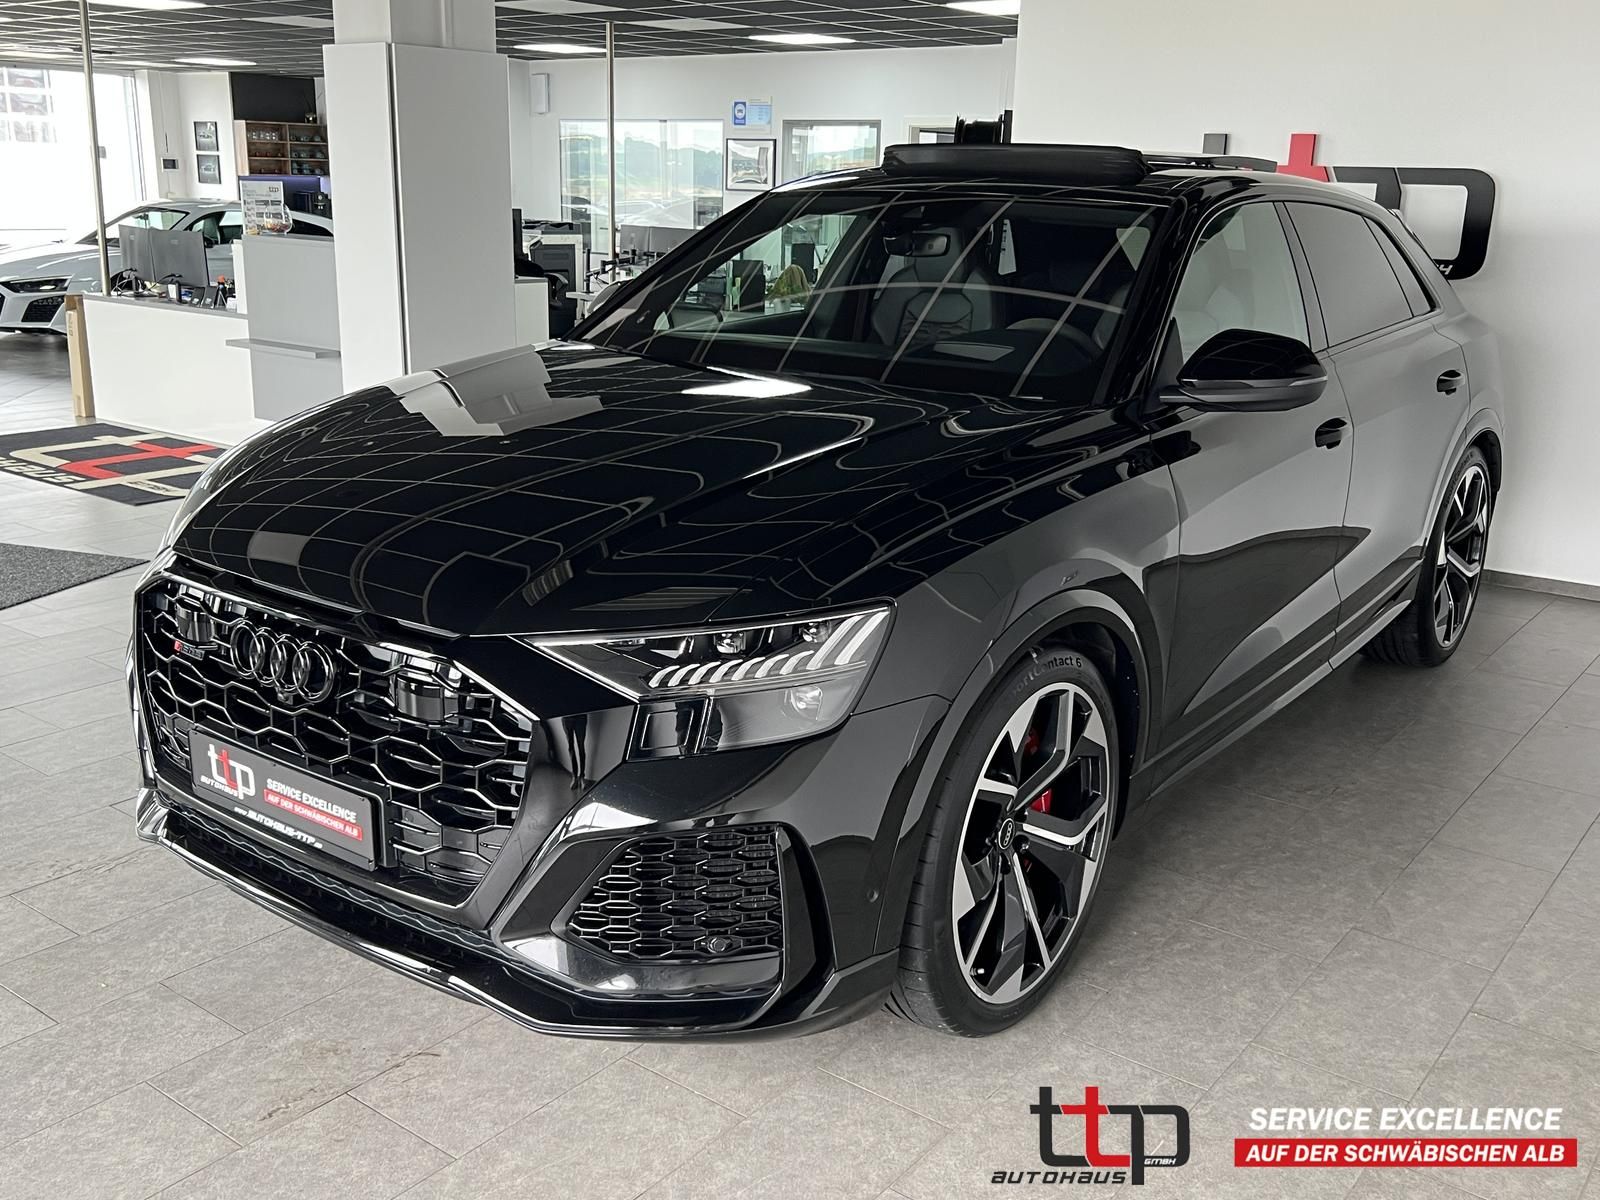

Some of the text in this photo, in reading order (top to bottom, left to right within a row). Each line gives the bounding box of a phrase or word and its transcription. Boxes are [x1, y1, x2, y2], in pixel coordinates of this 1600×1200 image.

[1013, 655, 1082, 697] ortContact 6
[207, 743, 255, 799] ttp
[266, 778, 357, 823] SERVICE EXCELLENCE
[267, 793, 280, 804] AUF
[344, 826, 359, 837] ALB
